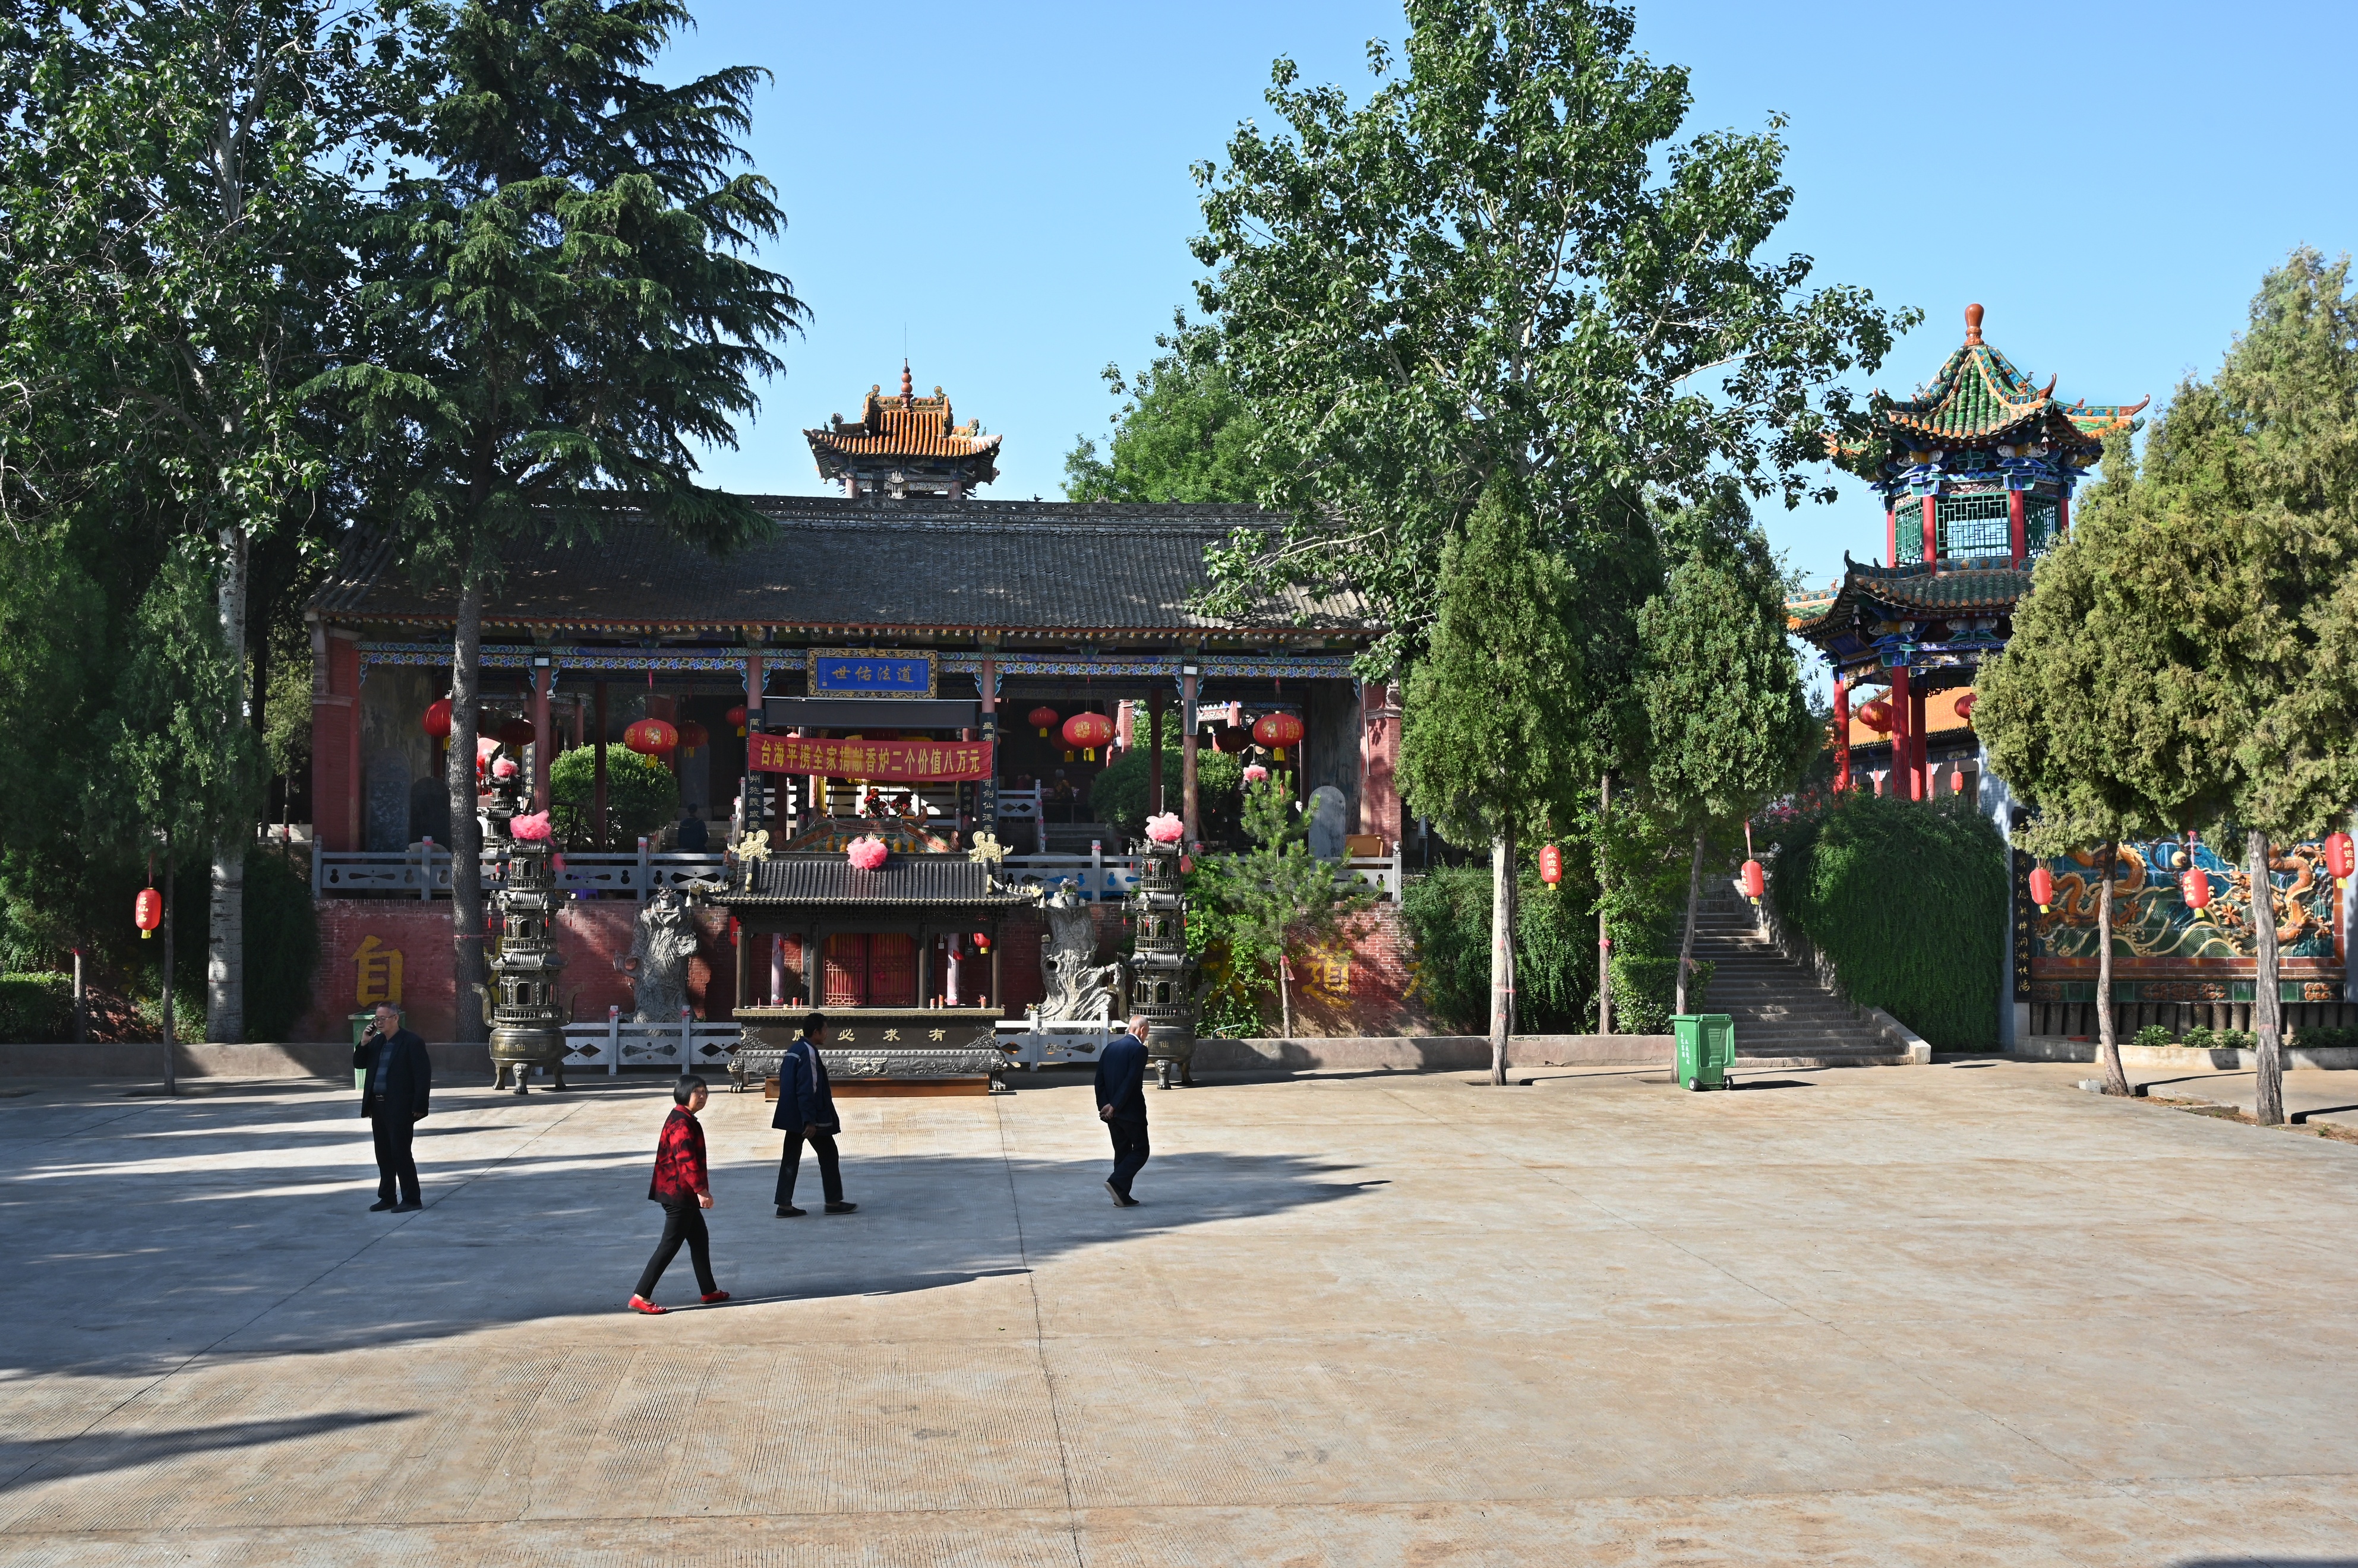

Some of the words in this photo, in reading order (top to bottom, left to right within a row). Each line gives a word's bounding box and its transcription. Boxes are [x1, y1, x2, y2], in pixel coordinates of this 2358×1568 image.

[832, 665, 914, 682] 道法佑世
[525, 742, 534, 794] 廟中聲在後
[761, 739, 980, 774] 台海平携全家捐献香炉二个价值八万元
[1546, 852, 1558, 876] 欢迎您
[2342, 840, 2354, 869] 欢迎您
[137, 897, 149, 922] 吕仙庙
